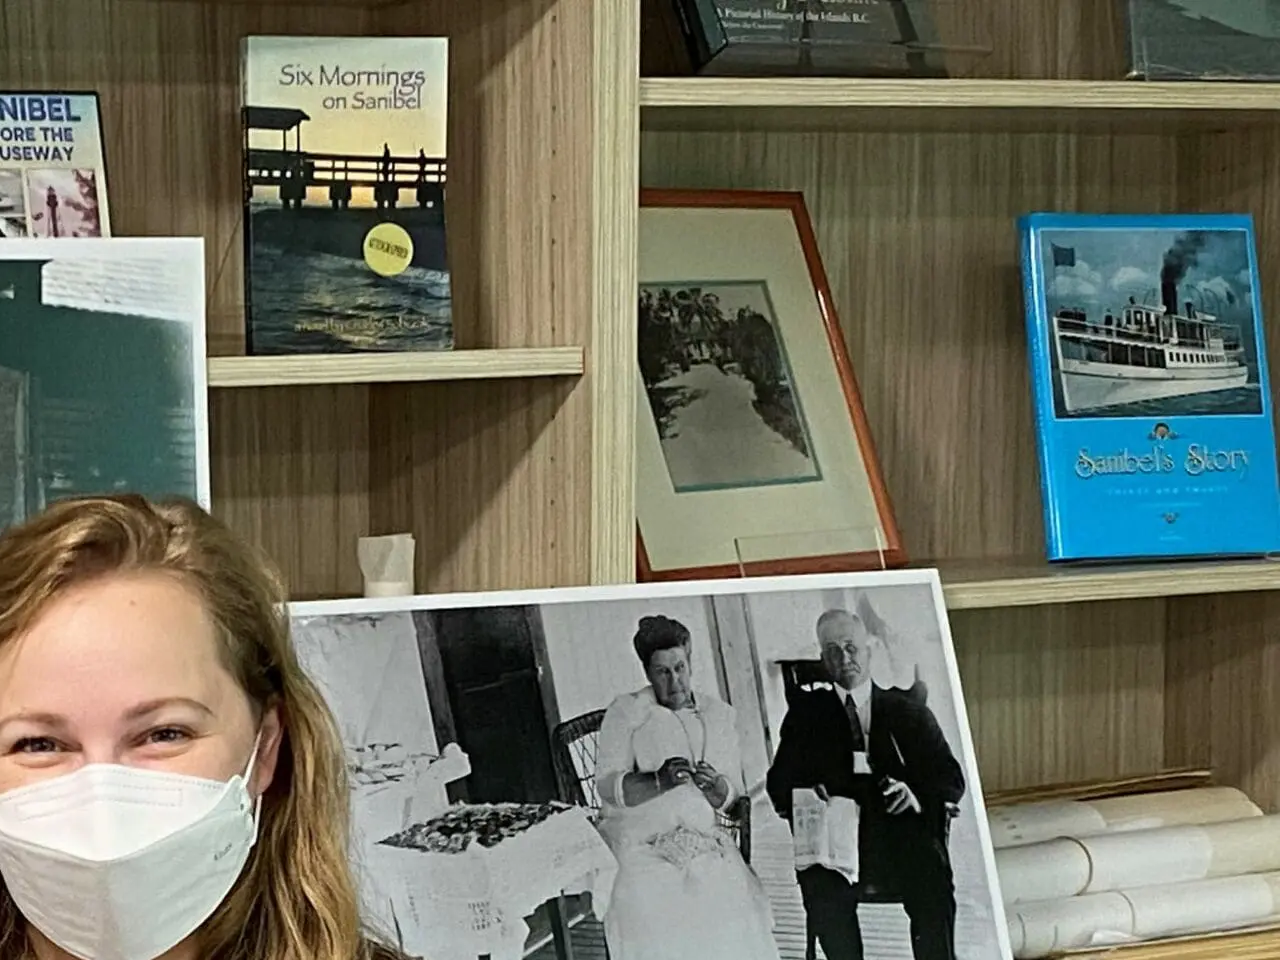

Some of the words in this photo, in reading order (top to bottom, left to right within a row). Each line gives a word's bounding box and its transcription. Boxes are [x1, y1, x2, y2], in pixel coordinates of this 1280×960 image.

[279, 64, 313, 86] Six
[319, 63, 425, 96] Mornings
[322, 96, 346, 109] on
[351, 85, 421, 109] Sanibel
[39, 127, 74, 142] THE
[1075, 443, 1176, 479] Sanibel's
[1184, 443, 1250, 479] Story
